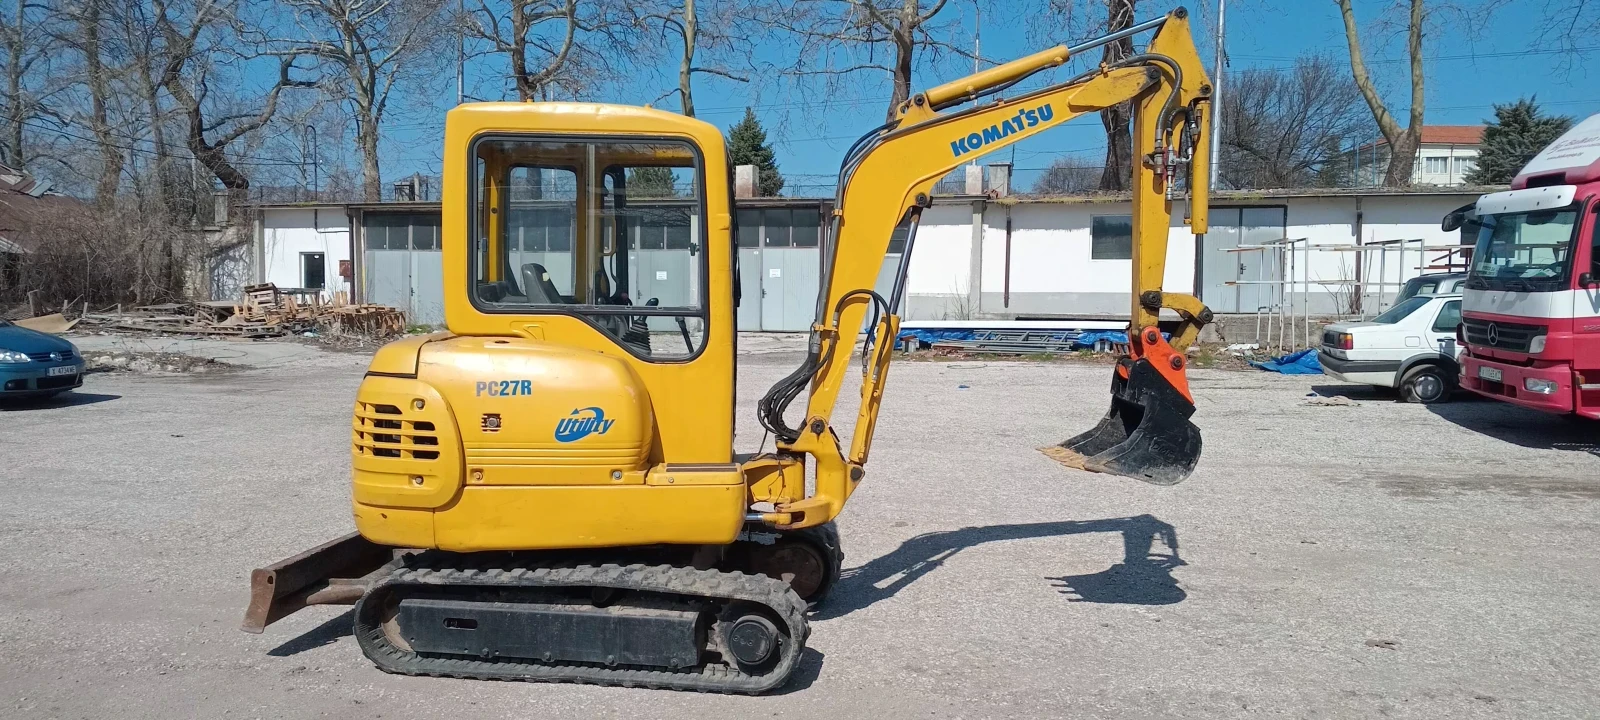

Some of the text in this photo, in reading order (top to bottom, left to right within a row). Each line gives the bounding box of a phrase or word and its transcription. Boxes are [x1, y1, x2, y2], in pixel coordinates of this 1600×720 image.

[950, 103, 1054, 157] KOMATSU
[476, 380, 532, 397] PC27R
[557, 415, 615, 435] Utility
